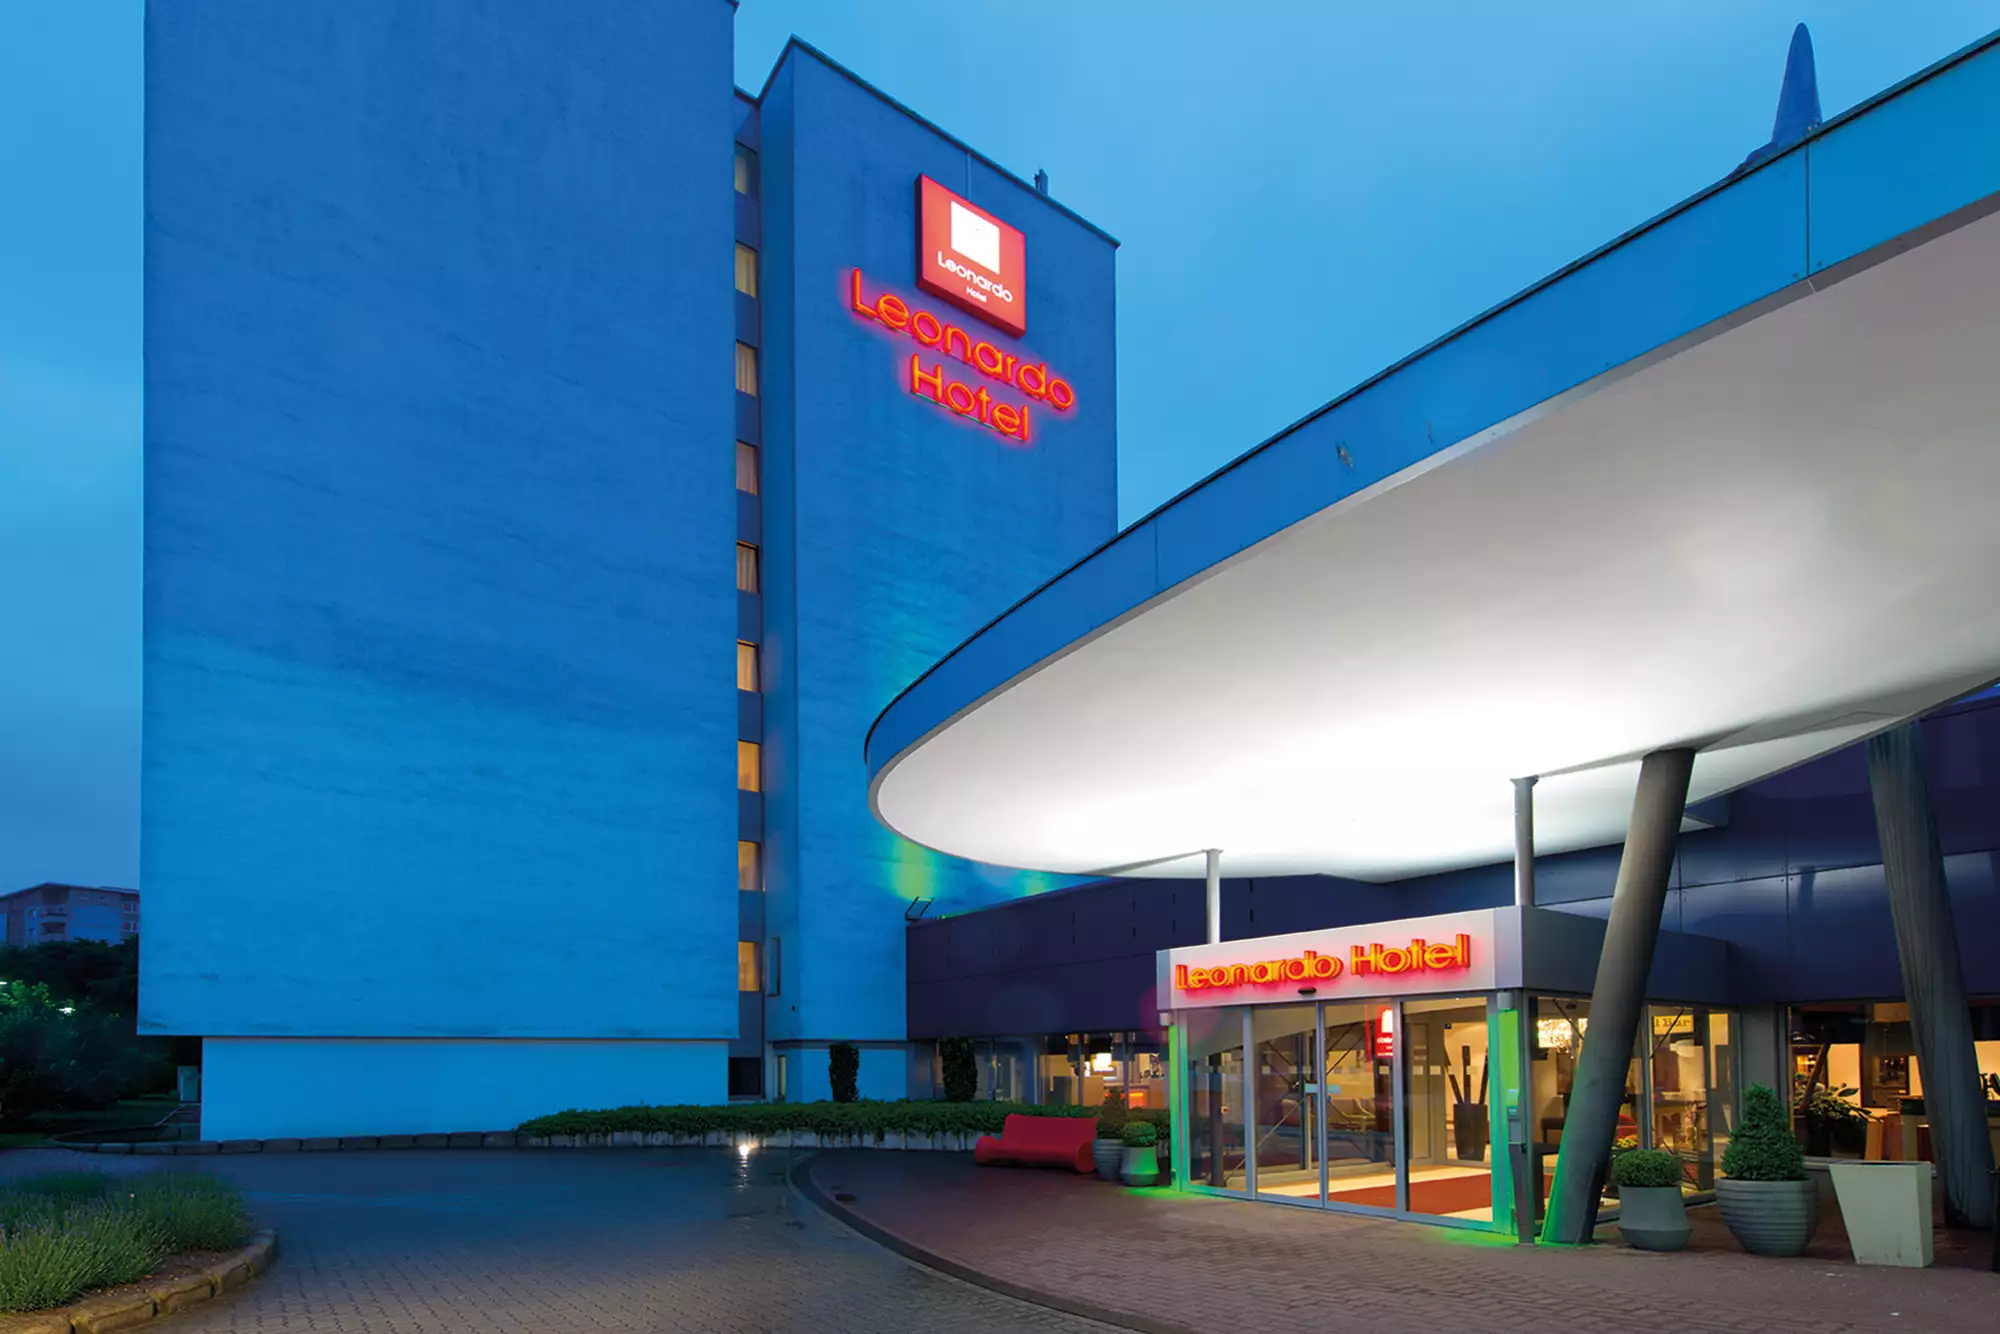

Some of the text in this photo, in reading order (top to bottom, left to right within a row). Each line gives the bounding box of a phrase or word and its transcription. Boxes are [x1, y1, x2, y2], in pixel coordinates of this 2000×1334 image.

[938, 251, 1013, 302] Leonardo
[966, 286, 987, 302] Hotel
[853, 268, 1074, 411] Leonardo
[911, 353, 1028, 441] Hotel
[1176, 934, 1469, 989] Leonardo Hotel
